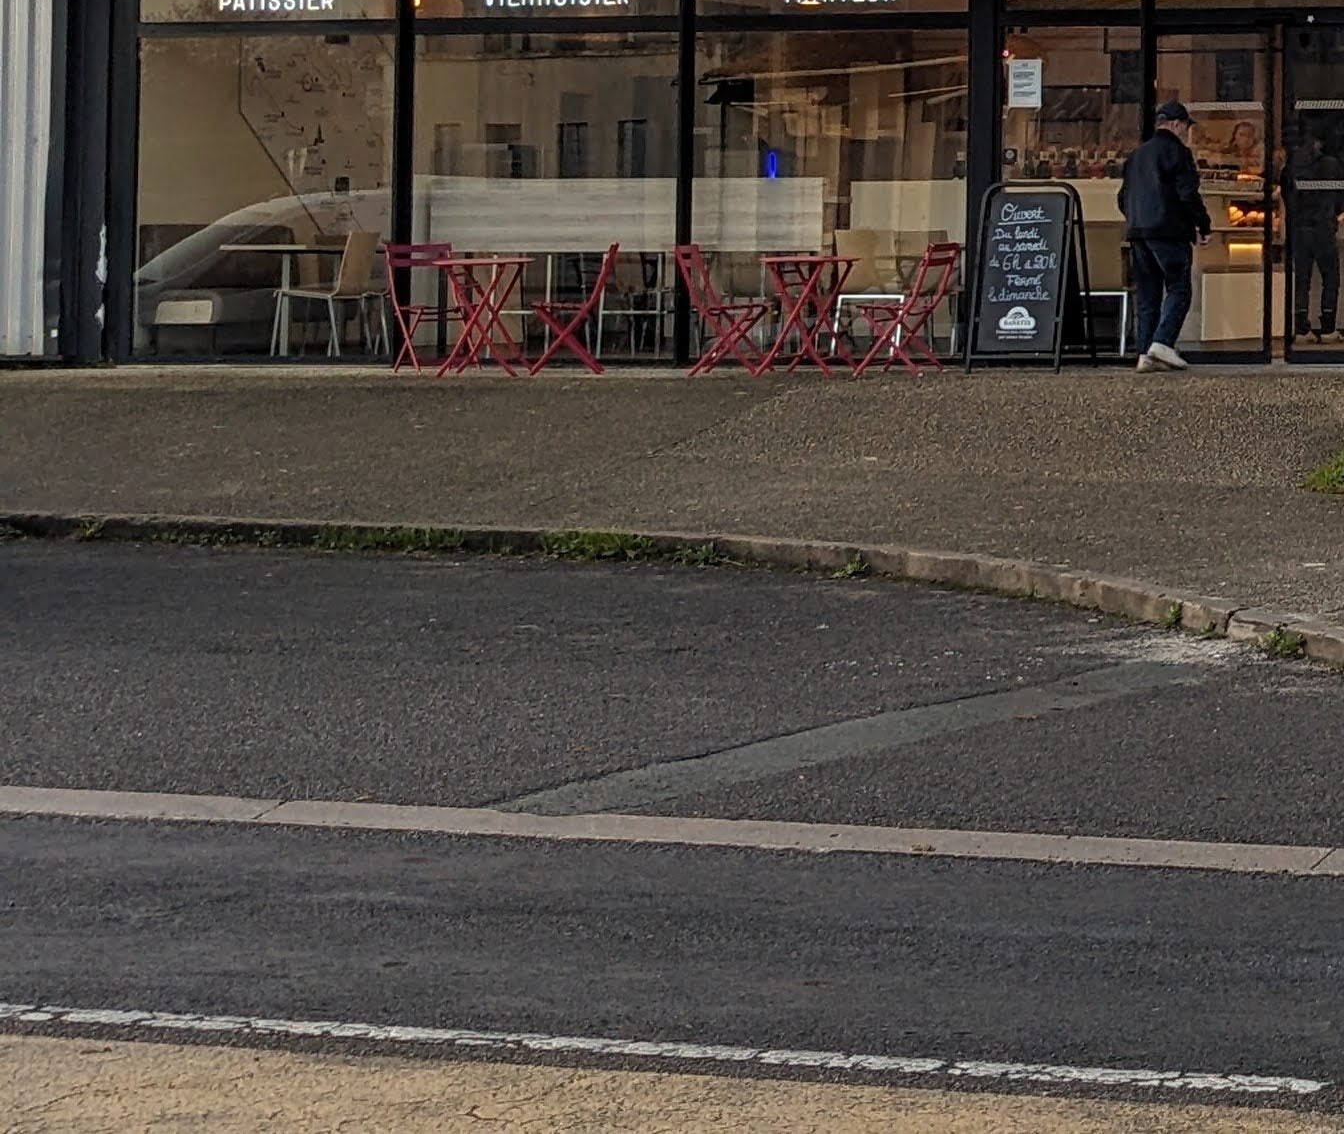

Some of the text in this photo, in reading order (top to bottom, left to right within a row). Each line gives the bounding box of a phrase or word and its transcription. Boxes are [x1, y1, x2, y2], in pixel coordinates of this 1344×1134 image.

[1001, 203, 1046, 221] Ouvert
[992, 226, 1040, 241] Du lundi
[998, 238, 1049, 252] au samedi
[1002, 254, 1022, 271] 6h
[1033, 252, 1058, 269] 20h
[998, 286, 1051, 301] dimanche
